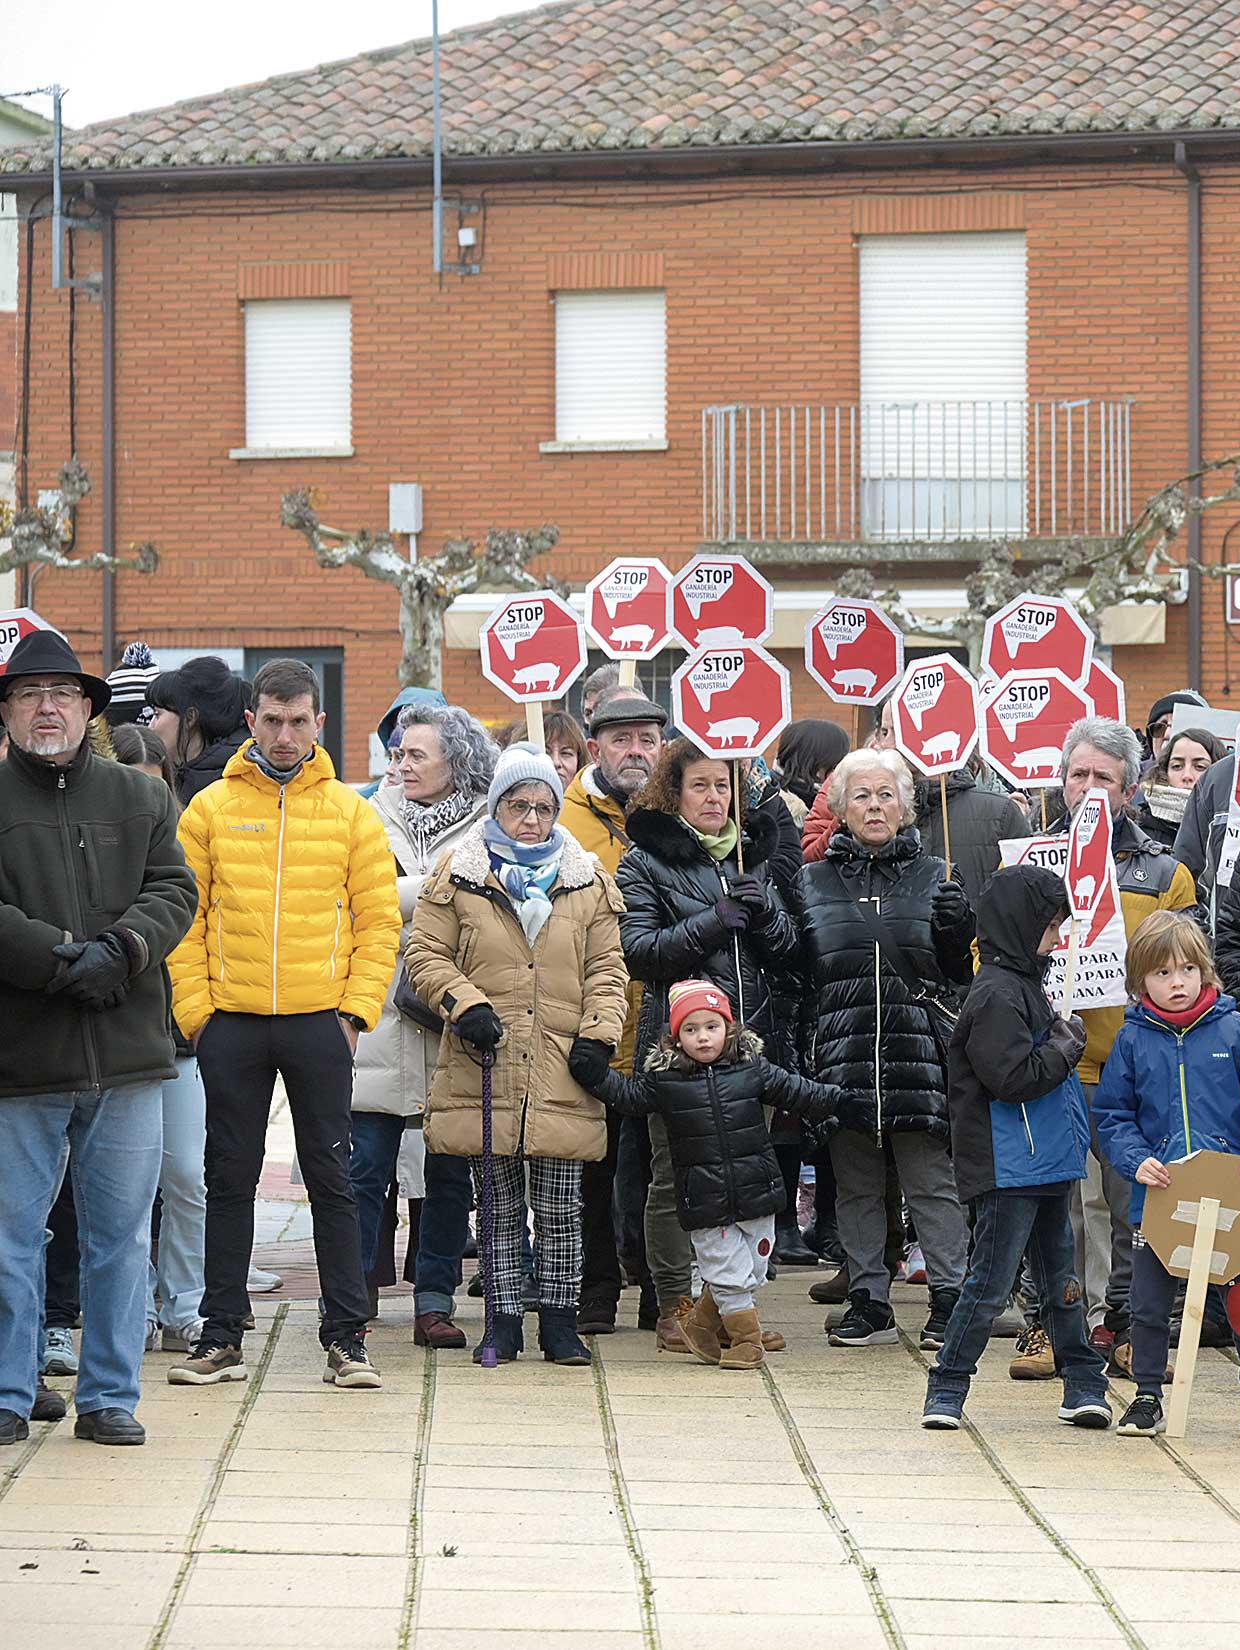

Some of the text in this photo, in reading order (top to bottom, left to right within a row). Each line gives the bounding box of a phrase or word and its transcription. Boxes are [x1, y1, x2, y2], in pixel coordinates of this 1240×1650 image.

[614, 572, 647, 584] STOP
[695, 570, 732, 584] STOP
[685, 583, 717, 591] GANADERÍA
[508, 606, 544, 623] STOP
[832, 612, 866, 627] STOP
[1017, 608, 1055, 626] STOP
[499, 623, 530, 632] GANADERÍA
[823, 624, 852, 634] GANADERÍA
[1006, 622, 1038, 632] GANADERÍA
[0, 628, 18, 644] OP
[823, 632, 853, 642] INDUSTRIAL
[1005, 631, 1038, 640] INDUSTRIAL
[703, 656, 744, 672] STOP
[693, 672, 728, 680] GANADERÍA
[913, 672, 944, 692] STOP
[694, 681, 729, 689] INDUSTRIAL
[906, 690, 933, 702] GANADERÍA
[1008, 686, 1048, 702] STOP
[908, 698, 934, 710] INDUSTRIAL
[998, 701, 1034, 710] GANADERÍA
[1000, 711, 1034, 720] INDUSTRIAL
[1084, 807, 1100, 823] STOP
[1079, 952, 1118, 965] PARA
[1085, 968, 1125, 980] PARA
